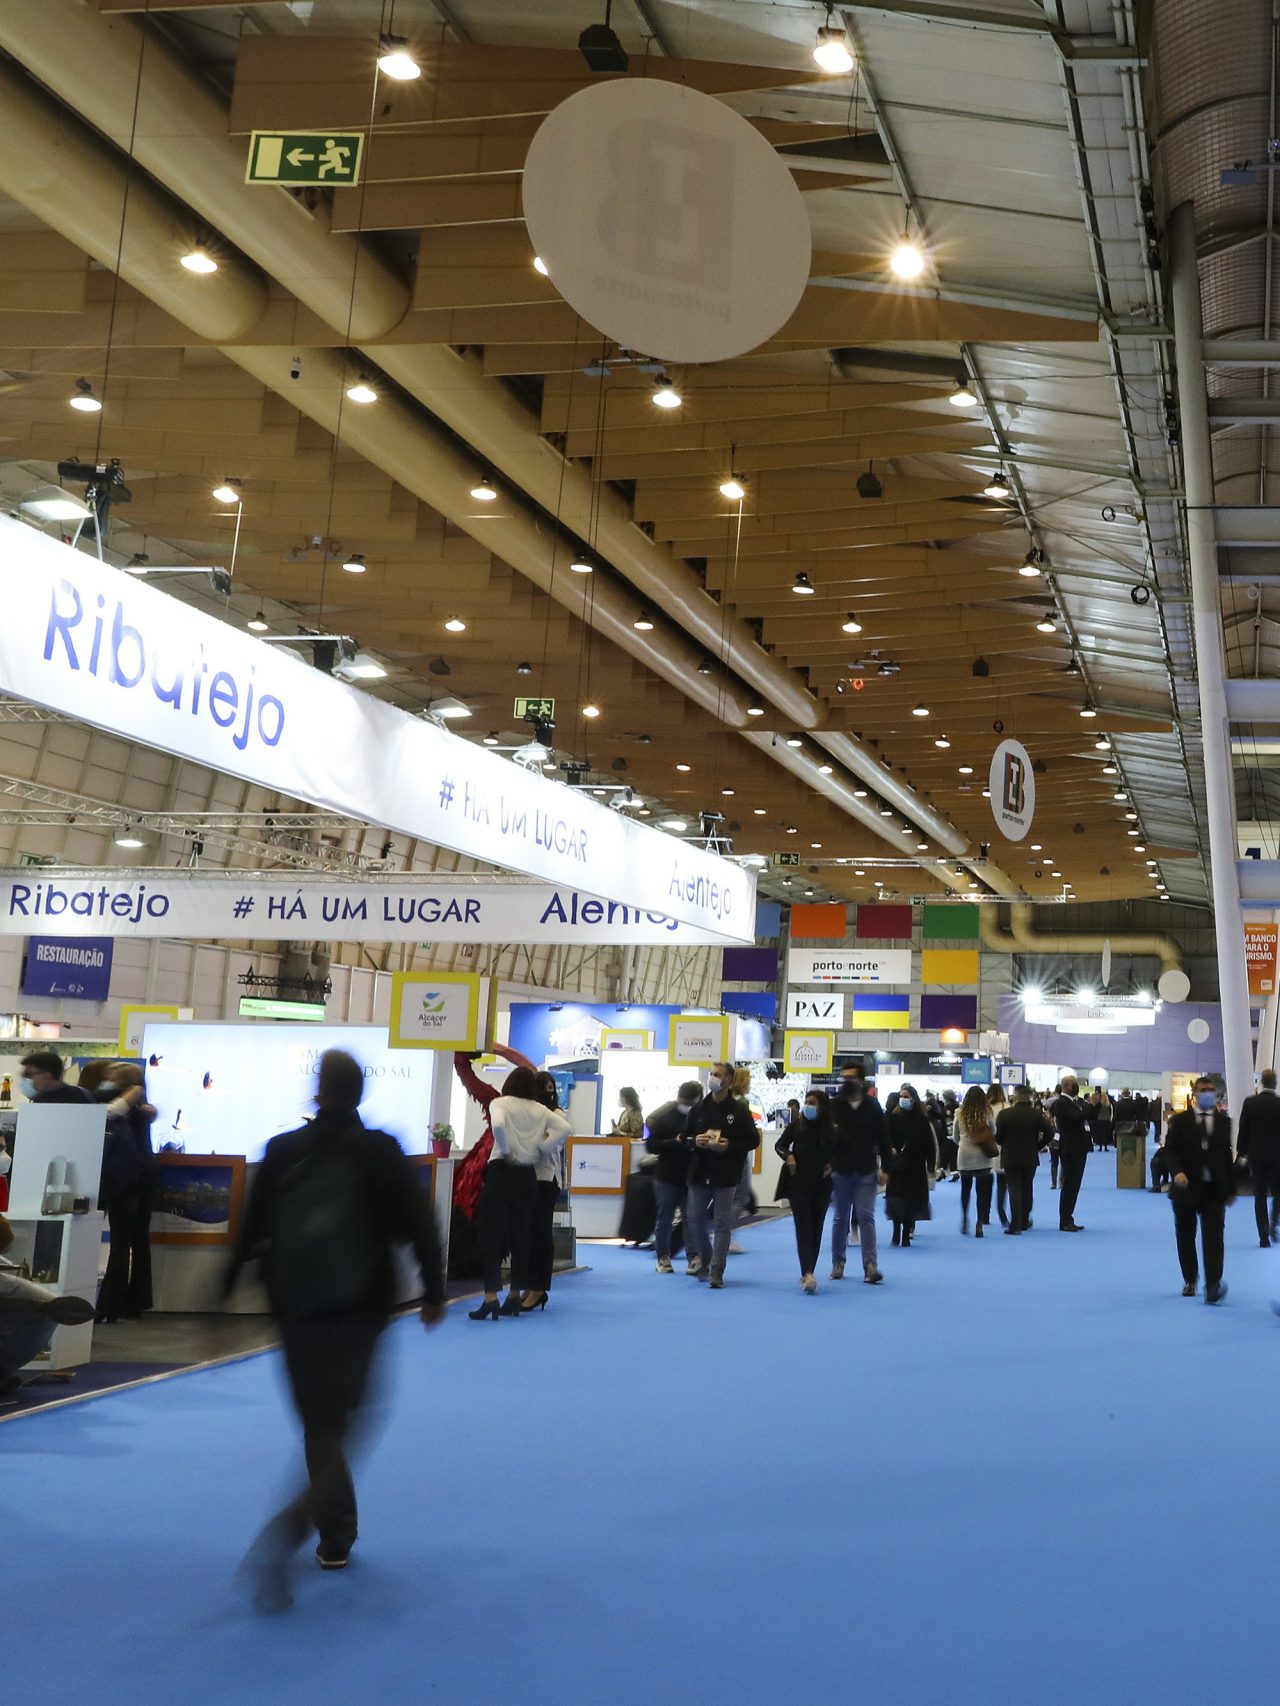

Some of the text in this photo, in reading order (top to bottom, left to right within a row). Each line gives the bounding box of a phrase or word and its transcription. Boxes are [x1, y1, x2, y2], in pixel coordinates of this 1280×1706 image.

[43, 576, 285, 750] Ribatejo
[500, 796, 528, 838] UM
[535, 808, 588, 863] LUGAR
[9, 884, 170, 923] Ribatejo
[268, 889, 307, 920] HÁ
[322, 897, 368, 922] UM
[383, 897, 481, 924] LUGAR
[668, 858, 732, 920] Alentejo
[37, 944, 104, 968] RESTAURAÇÃO
[1251, 934, 1277, 943] BANCO
[794, 1001, 837, 1018] PAZ
